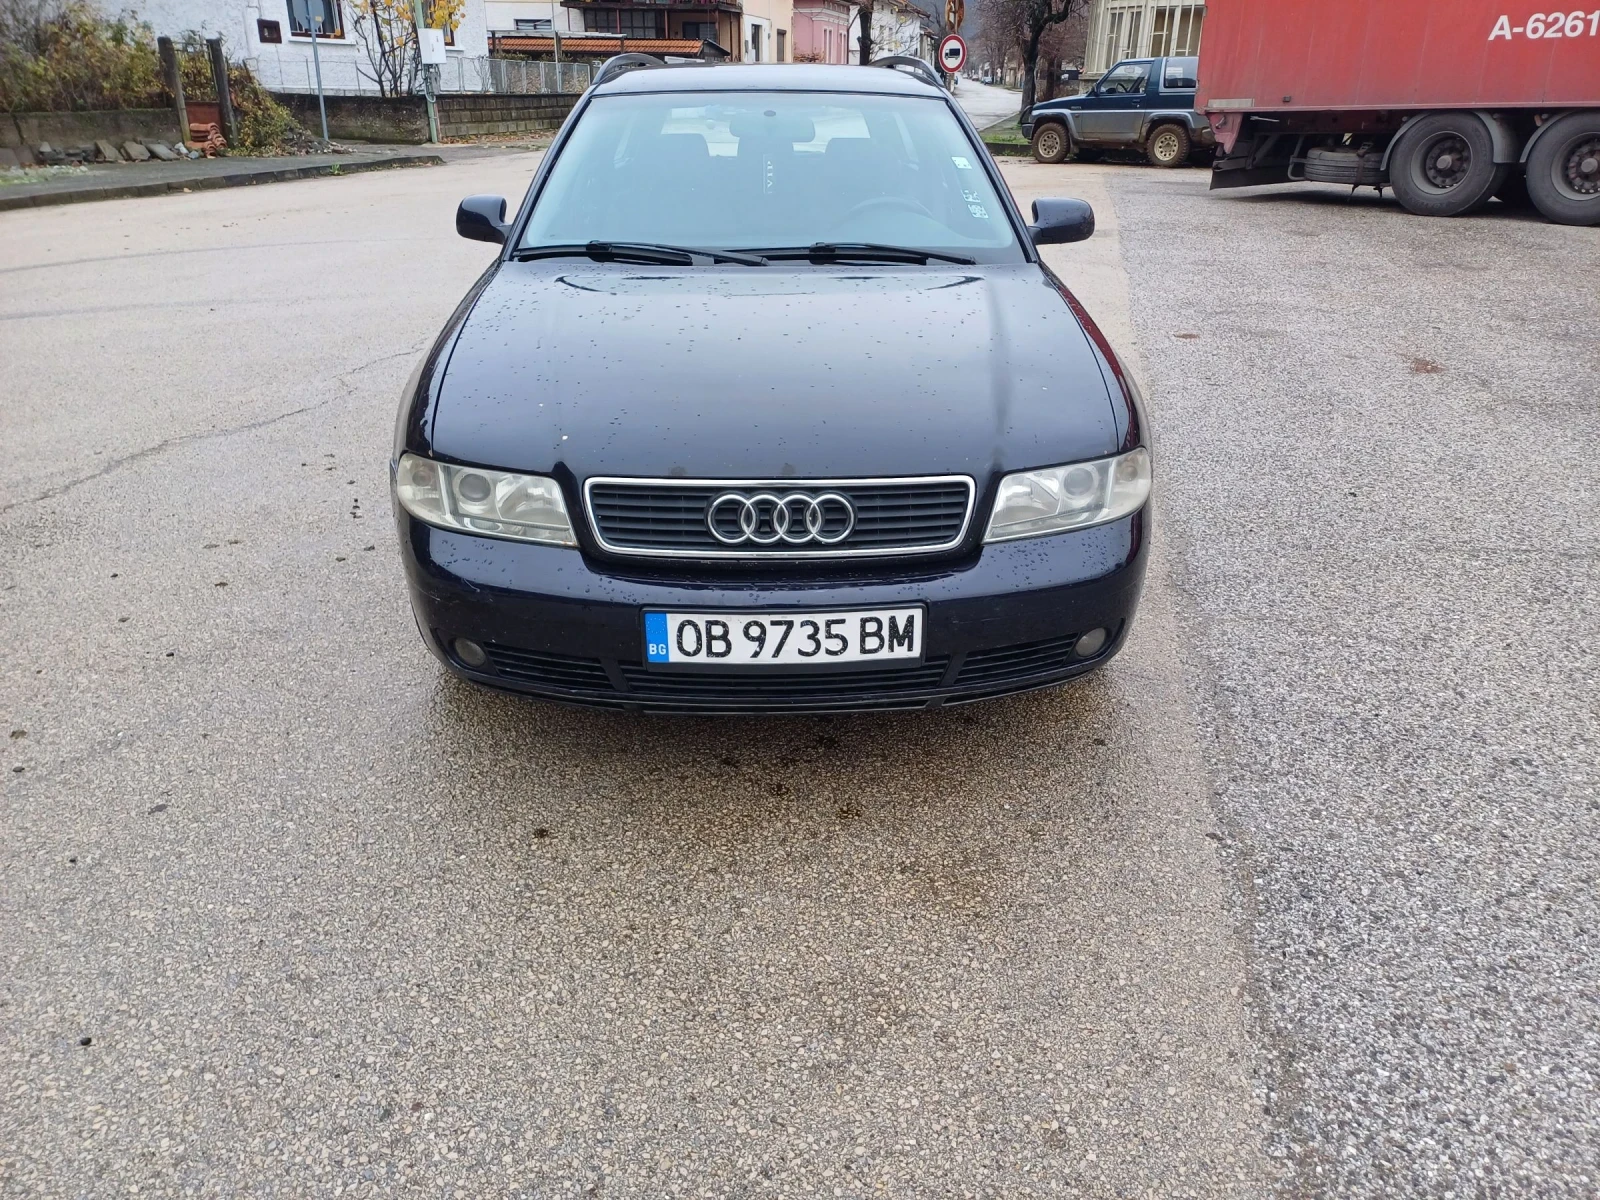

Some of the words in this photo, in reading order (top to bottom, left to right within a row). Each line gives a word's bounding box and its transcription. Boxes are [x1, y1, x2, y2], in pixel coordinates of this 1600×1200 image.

[1487, 10, 1600, 41] A-6261
[649, 643, 667, 655] BG
[676, 619, 732, 658] OB
[743, 618, 849, 658] 9735
[860, 614, 915, 655] BM
